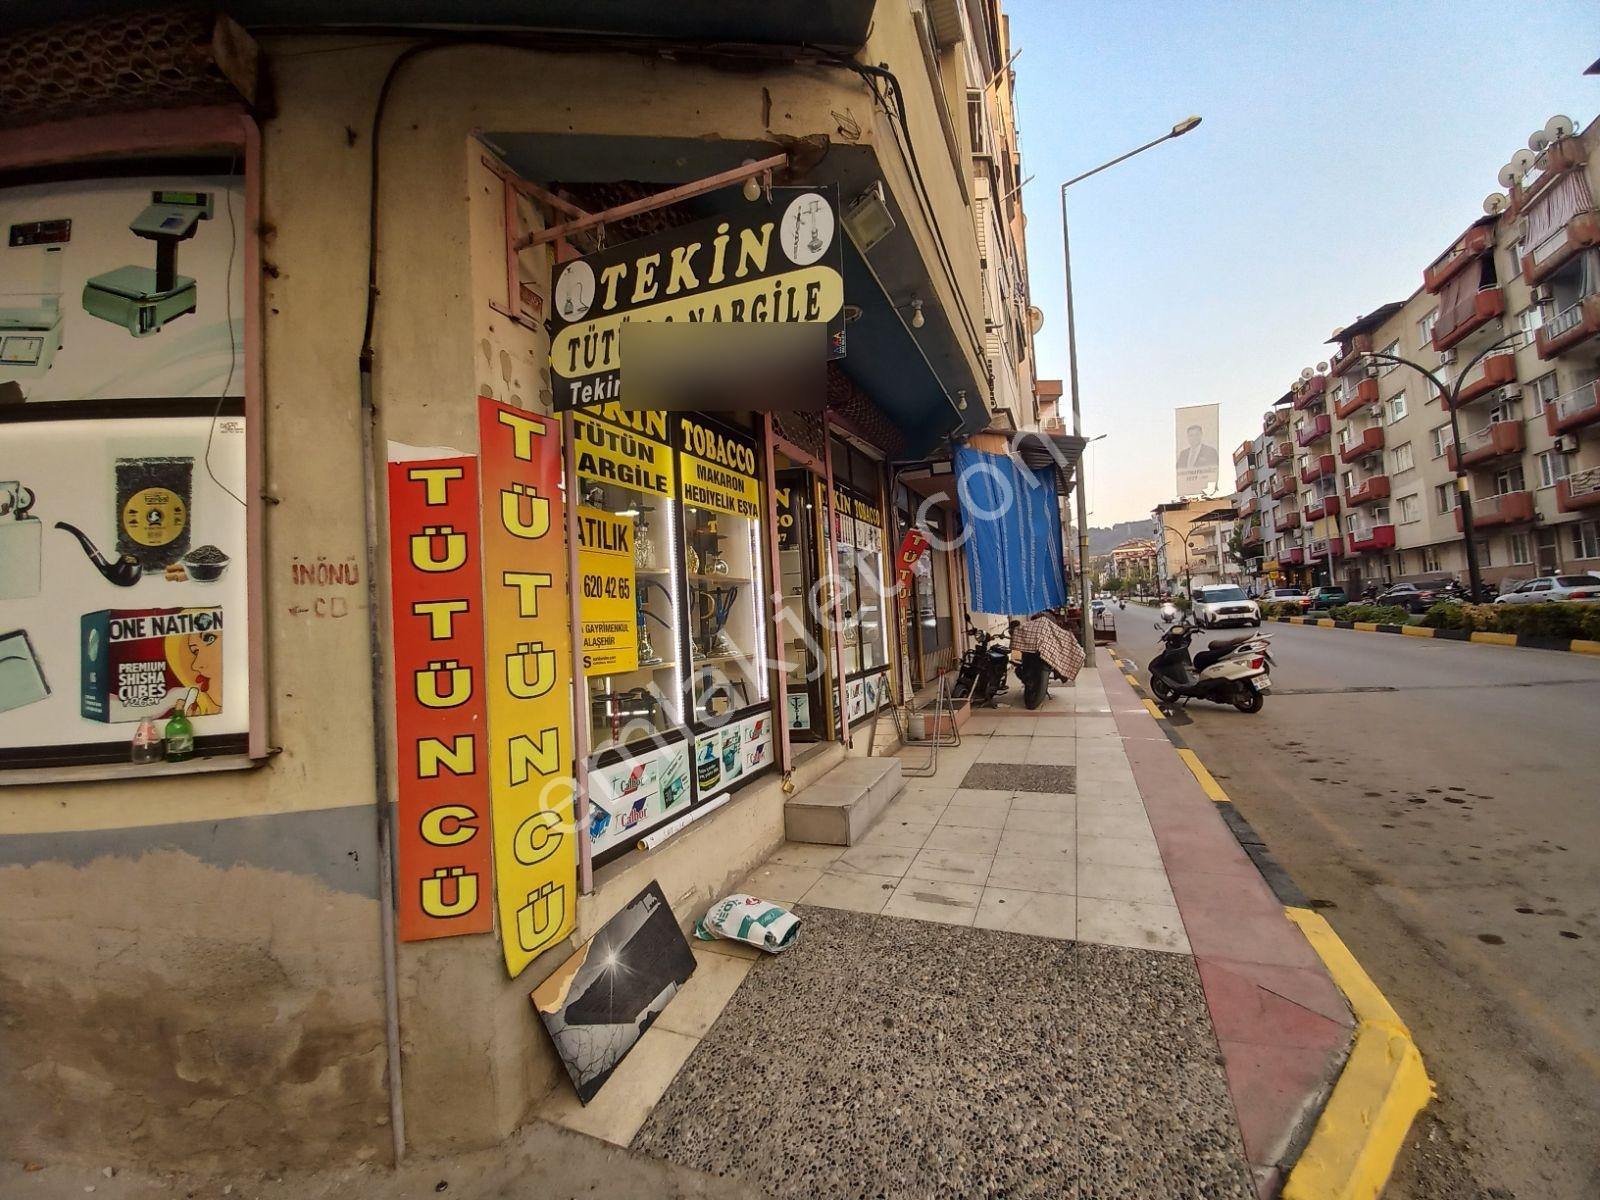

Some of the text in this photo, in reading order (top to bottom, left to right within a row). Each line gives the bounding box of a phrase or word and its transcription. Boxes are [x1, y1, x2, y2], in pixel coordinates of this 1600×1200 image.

[601, 222, 775, 311] TEKİN
[688, 279, 821, 323] RGİLE
[573, 419, 655, 465] TÜTÜN
[681, 418, 755, 475] TOBACCO
[577, 451, 668, 493] ARGİLE
[696, 463, 745, 493] MAKARON
[684, 483, 759, 517] HEDİYELİK EŞYA
[854, 499, 881, 526] TOBACCO
[292, 555, 359, 587] İNÖNÜ
[583, 574, 603, 599] 620
[605, 576, 617, 599] 42
[618, 577, 630, 600] 65
[110, 610, 224, 641] ONE NATION
[585, 621, 629, 634] GAYRİMENKUL
[118, 661, 167, 674] PREMIUM
[118, 672, 167, 687] SHISHA
[497, 407, 566, 954] TÜTÜNCÜ
[118, 684, 167, 701] CUBES
[407, 467, 479, 919] TÜTÜNCÜ
